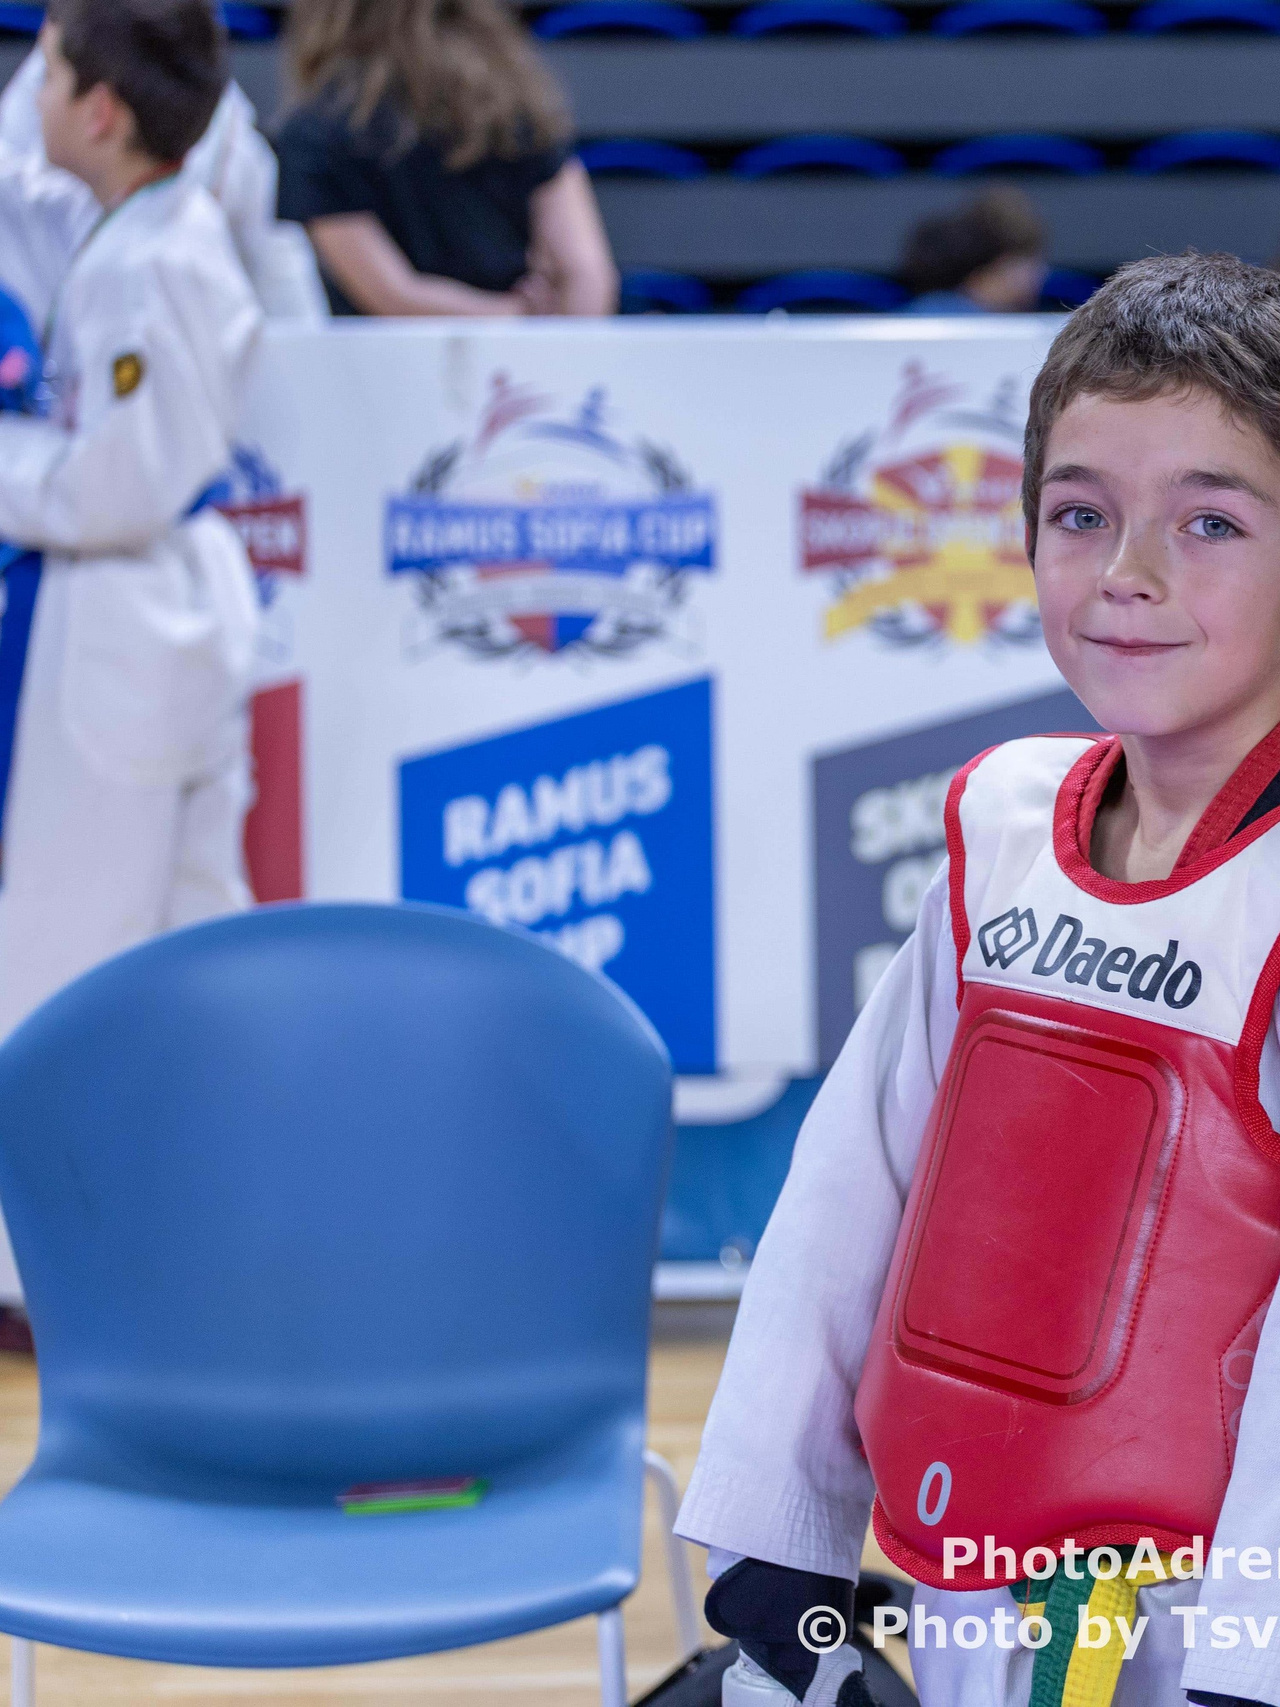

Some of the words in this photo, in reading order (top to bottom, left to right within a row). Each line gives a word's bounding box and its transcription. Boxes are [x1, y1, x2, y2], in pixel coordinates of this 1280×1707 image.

[390, 512, 521, 558] RAMUS
[525, 511, 633, 557] SOFIA
[637, 509, 714, 555] CUP
[441, 742, 676, 868] RAMUS
[463, 829, 653, 929] SOFIA
[1031, 913, 1203, 1010] Daedo
